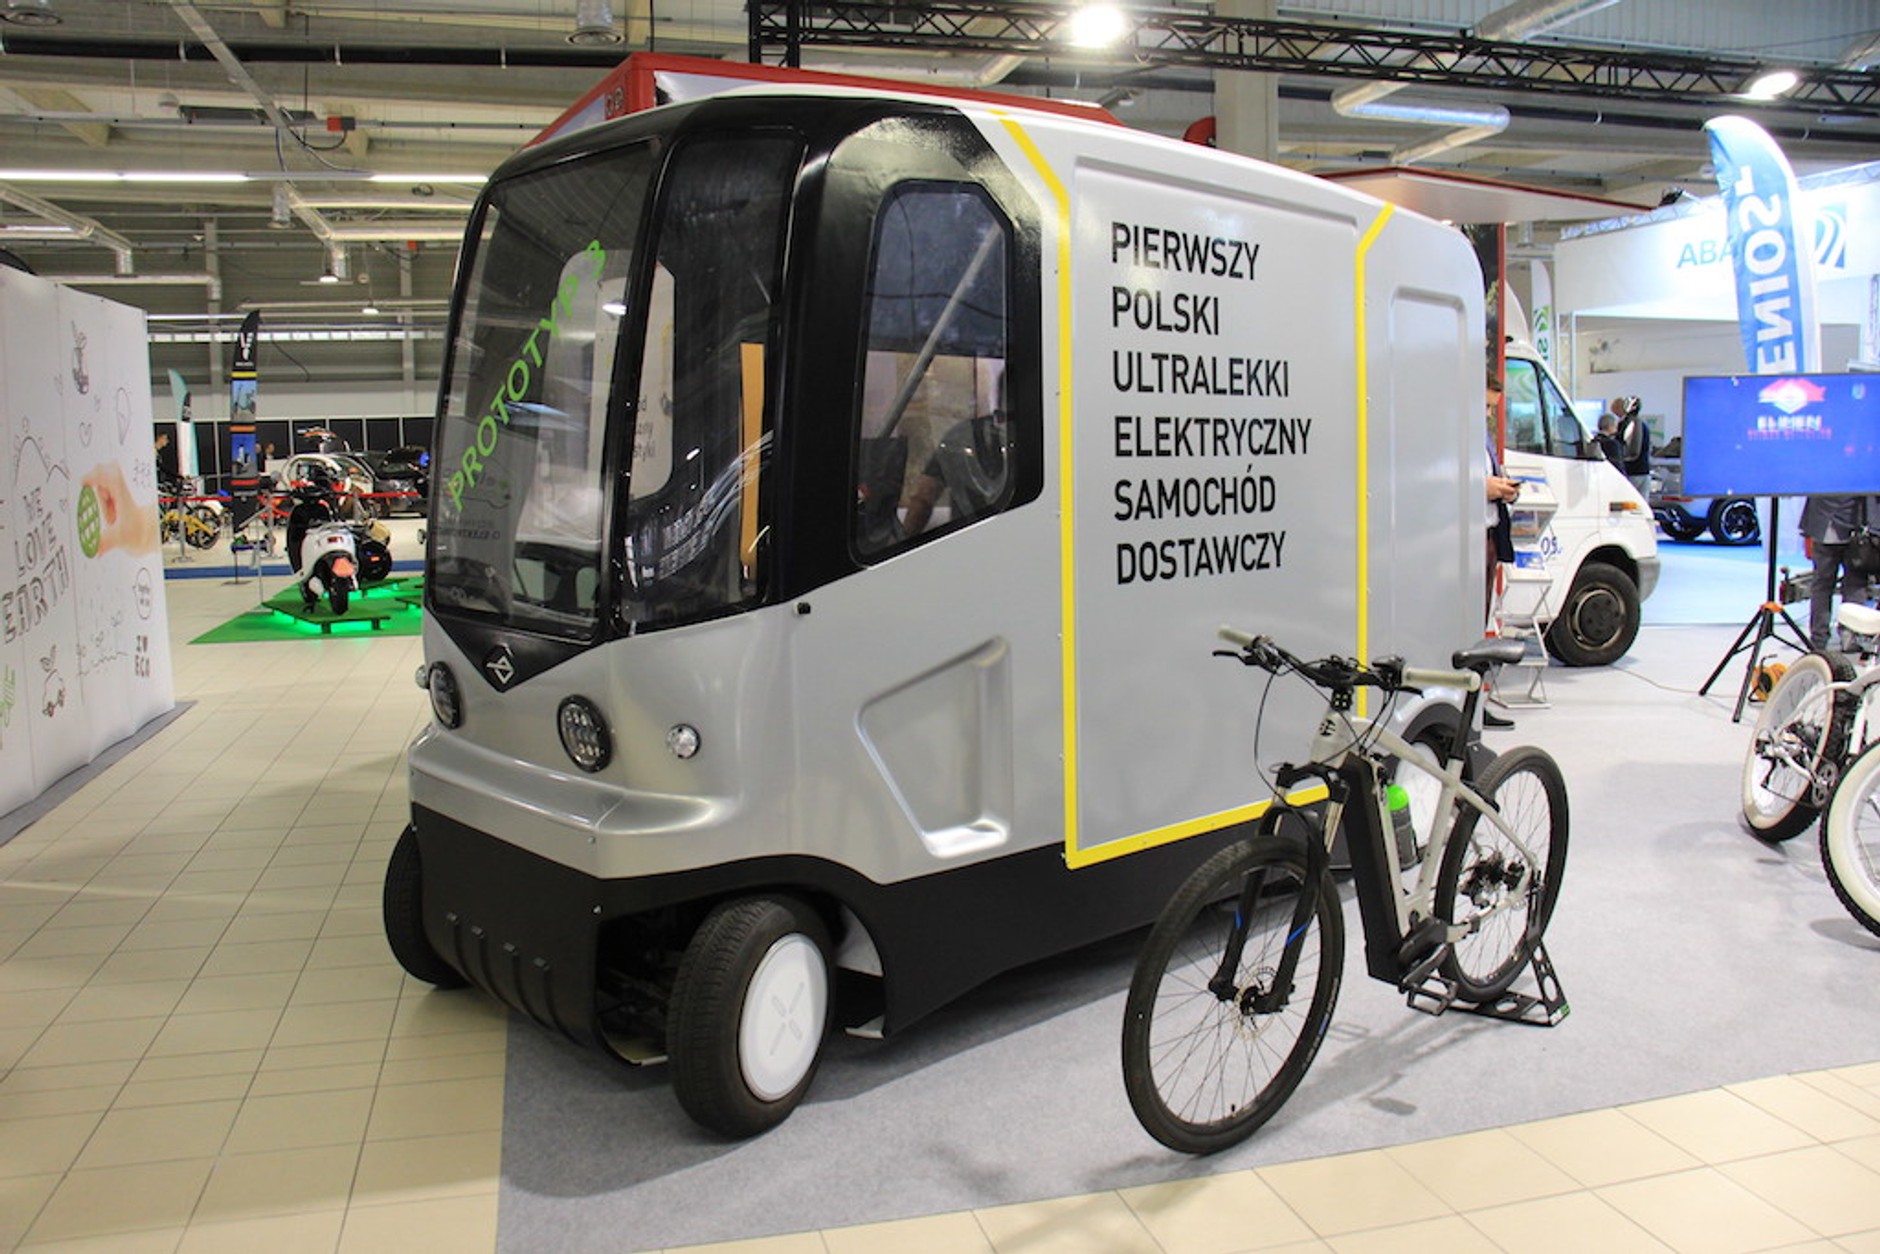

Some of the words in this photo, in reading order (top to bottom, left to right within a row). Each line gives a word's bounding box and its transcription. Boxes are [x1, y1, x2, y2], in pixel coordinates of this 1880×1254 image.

[1111, 222, 1260, 280] PIERWSZY
[1112, 286, 1220, 335] POLSKI
[449, 274, 578, 512] PROTOTYP
[585, 239, 607, 278] 3
[1113, 351, 1289, 397] ULTRALEKKI
[1114, 416, 1312, 457] ELEKTRYCZNY
[1114, 464, 1276, 521] SAMOCHÓD
[15, 511, 56, 578] LOVE
[1116, 531, 1286, 585] DOSTAWCZY
[2, 545, 70, 644] EARTH
